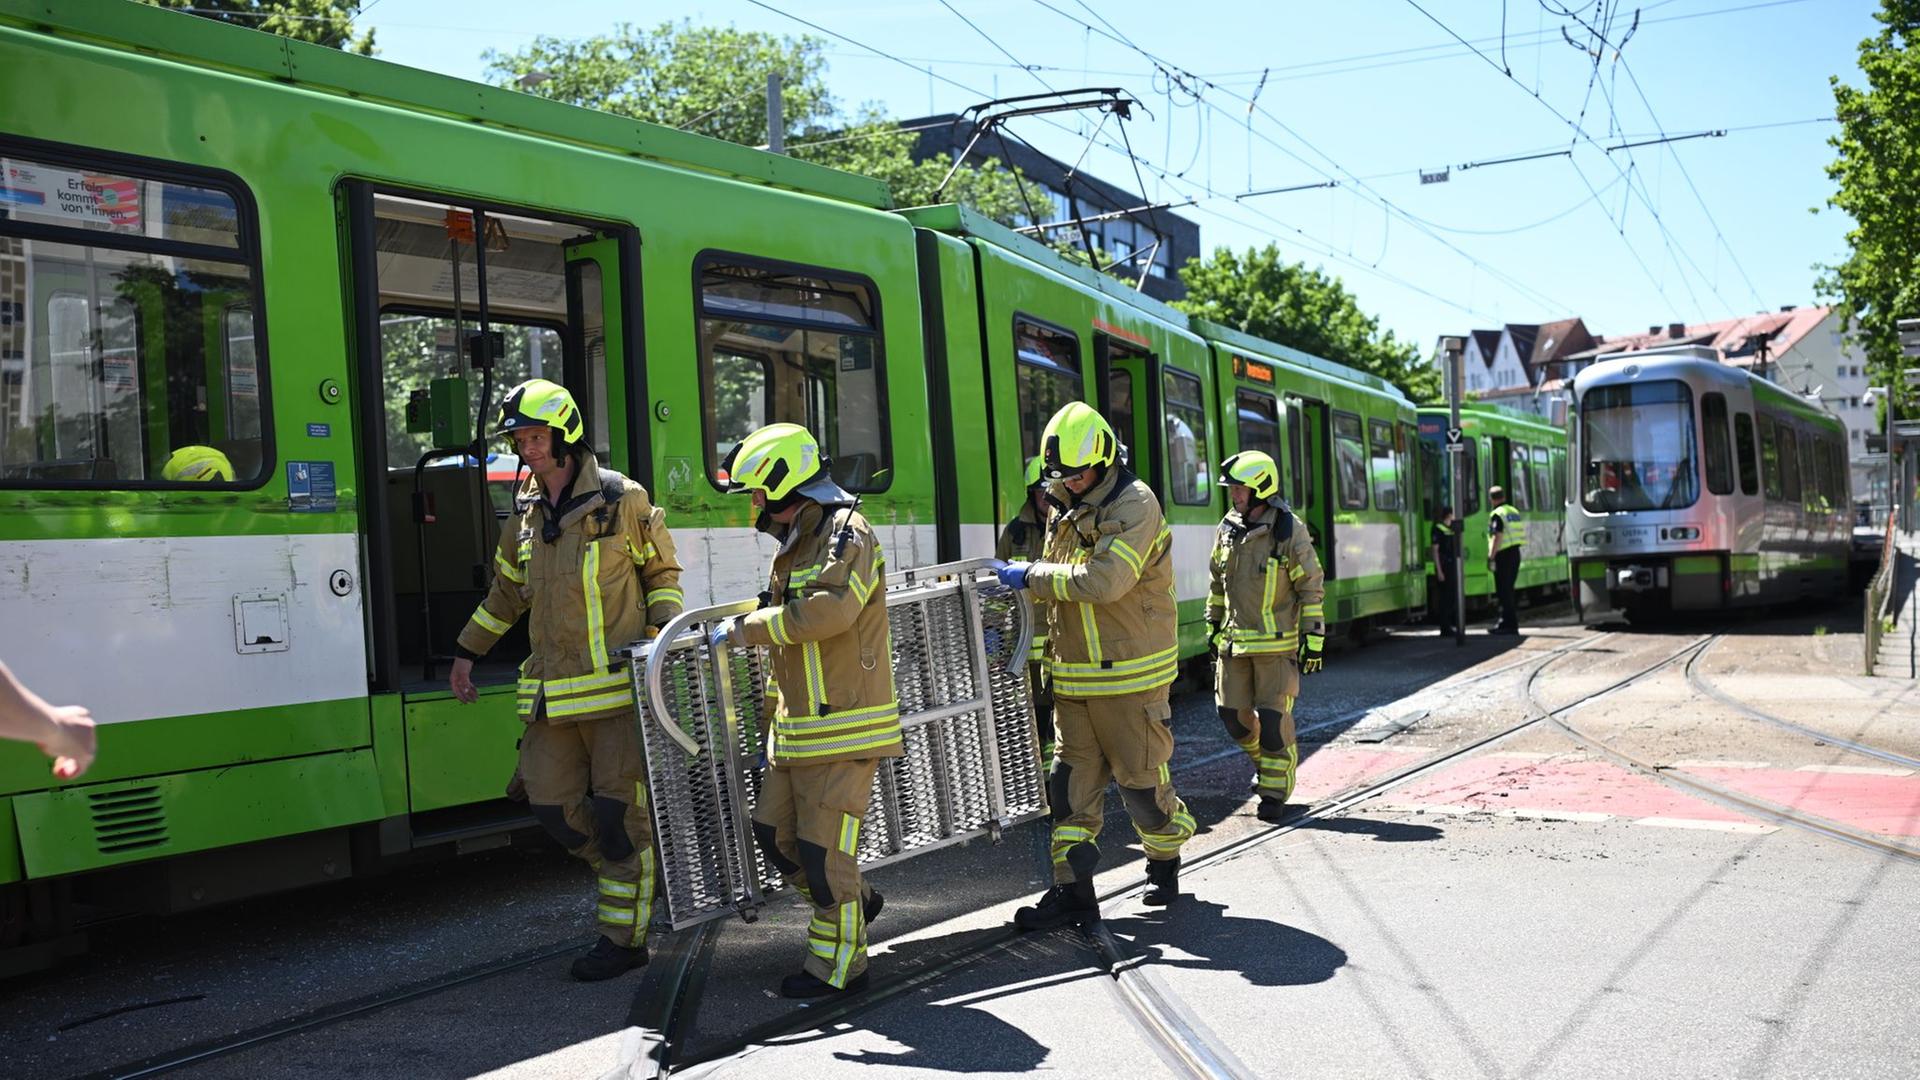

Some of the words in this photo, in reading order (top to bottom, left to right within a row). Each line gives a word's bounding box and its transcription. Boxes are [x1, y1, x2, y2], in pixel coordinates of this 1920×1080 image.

[1422, 173, 1448, 184] 83.08
[68, 178, 103, 197] Erfolg
[57, 188, 98, 205] kommt
[61, 203, 83, 214] von
